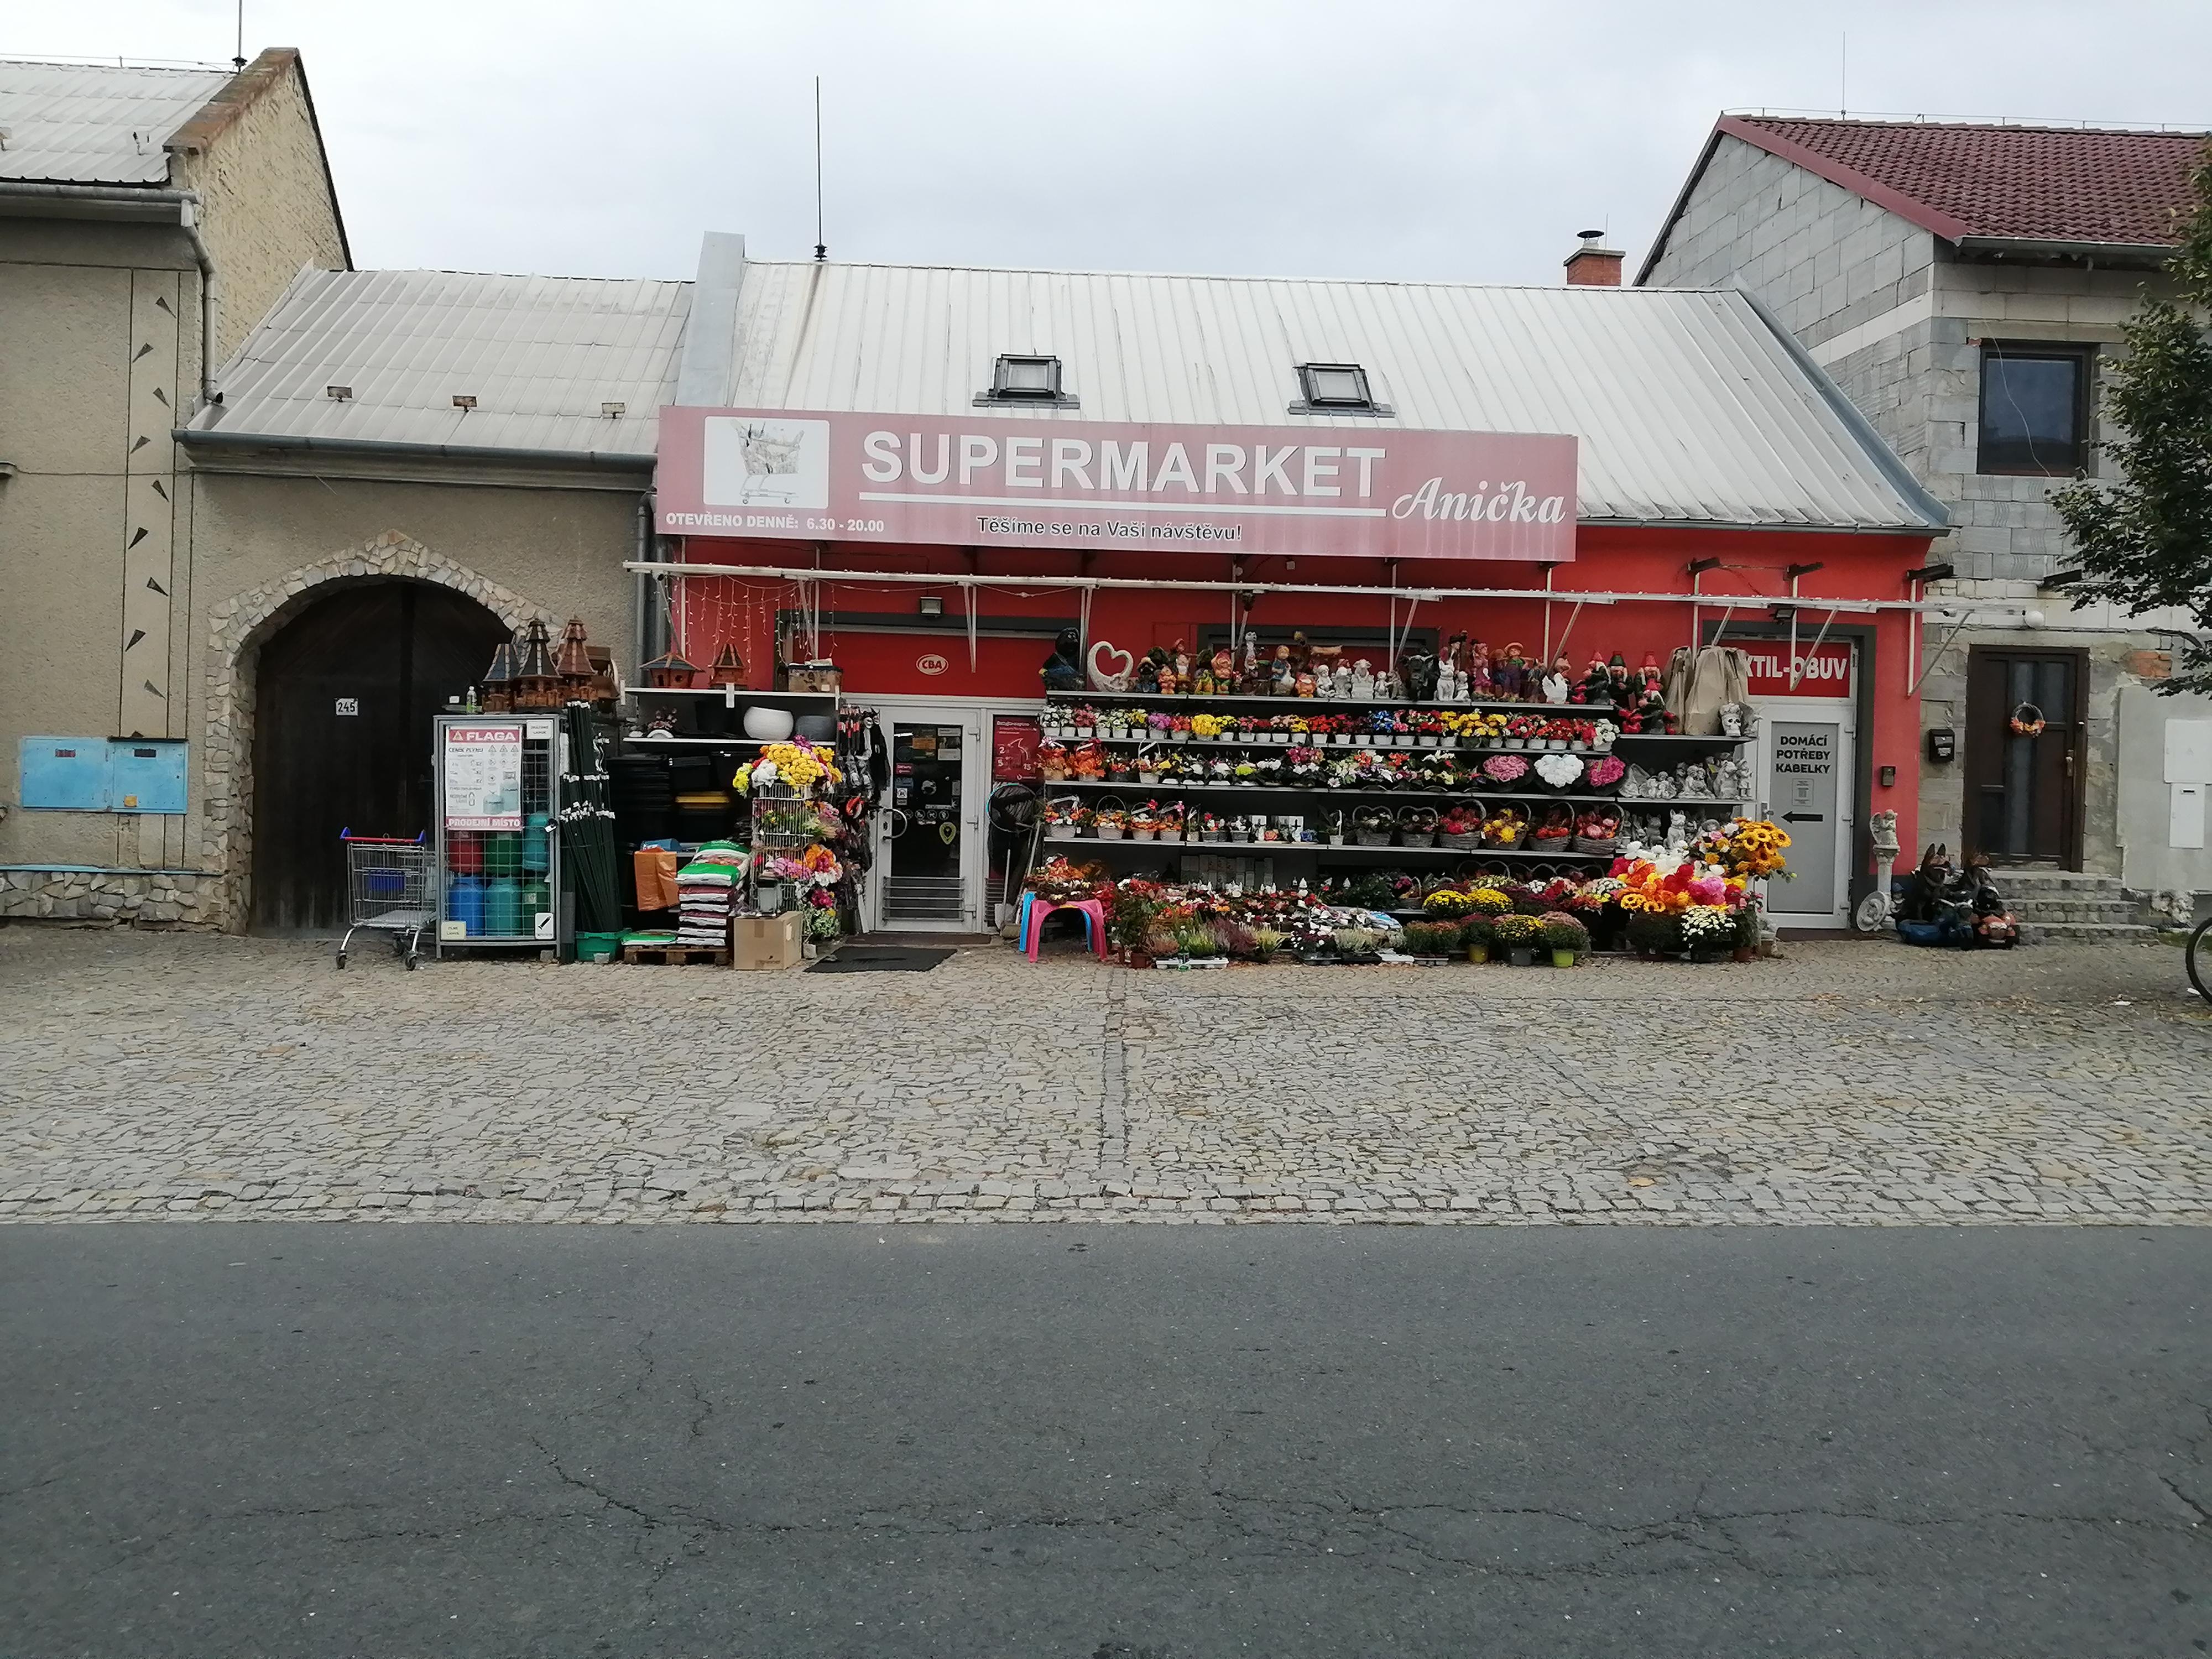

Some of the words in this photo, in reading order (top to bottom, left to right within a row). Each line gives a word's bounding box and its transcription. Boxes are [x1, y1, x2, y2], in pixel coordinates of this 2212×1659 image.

[861, 430, 1386, 498] SUPERMARKET
[1392, 477, 1567, 524] Anička
[665, 511, 743, 527] OTEVŘENO
[747, 514, 799, 529] DENNĚ:
[807, 518, 835, 530] 6.30
[847, 519, 884, 533] 20.00
[977, 517, 1044, 534] Těšíme
[1051, 522, 1073, 536] se
[1078, 523, 1101, 537] na
[1107, 520, 1146, 539] Vaši
[1151, 523, 1242, 541] návštěvu!
[922, 660, 942, 669] CBA
[1745, 655, 1848, 680] XTIL-OBUV
[338, 702, 356, 713] 245
[466, 732, 516, 741] FLAGA
[1780, 734, 1828, 747] DOMÁCÍ
[1776, 748, 1831, 760] POTŘEBY
[1776, 763, 1831, 774] KABELKY
